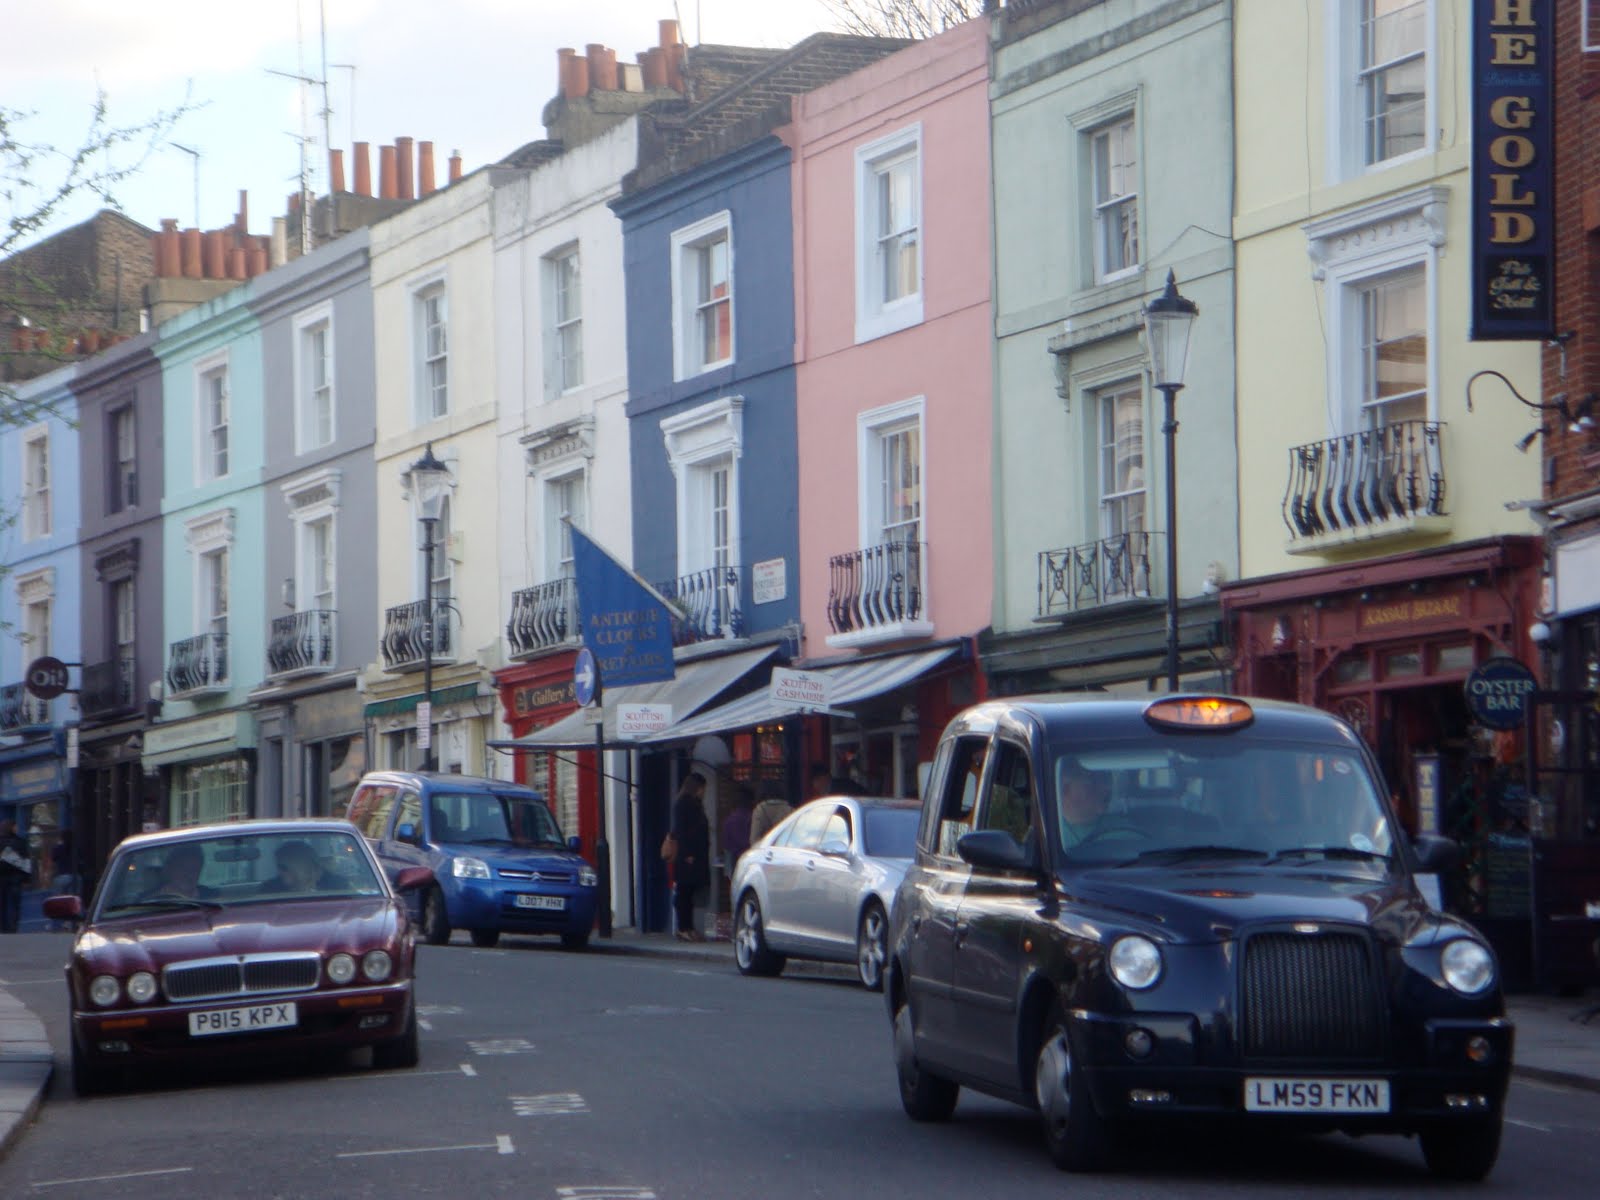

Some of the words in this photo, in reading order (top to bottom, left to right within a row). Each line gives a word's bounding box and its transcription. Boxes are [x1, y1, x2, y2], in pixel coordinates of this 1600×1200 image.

[1489, 96, 1536, 243] GOLD
[591, 609, 658, 628] ANTIQUE
[596, 625, 657, 645] CLOCKS
[31, 669, 64, 686] Oi!
[780, 679, 824, 692] SCOTTISH
[776, 688, 825, 702] CASHMERE
[1472, 679, 1534, 695] OYSTER
[532, 687, 565, 706] Gallery
[1487, 695, 1520, 711] BAR
[624, 711, 665, 721] SCOTTISH
[622, 722, 667, 731] CASHMERE
[197, 1011, 240, 1030] P815
[250, 1005, 289, 1025] KPX
[1256, 1083, 1323, 1107] LM59
[1331, 1084, 1379, 1107] FKN
